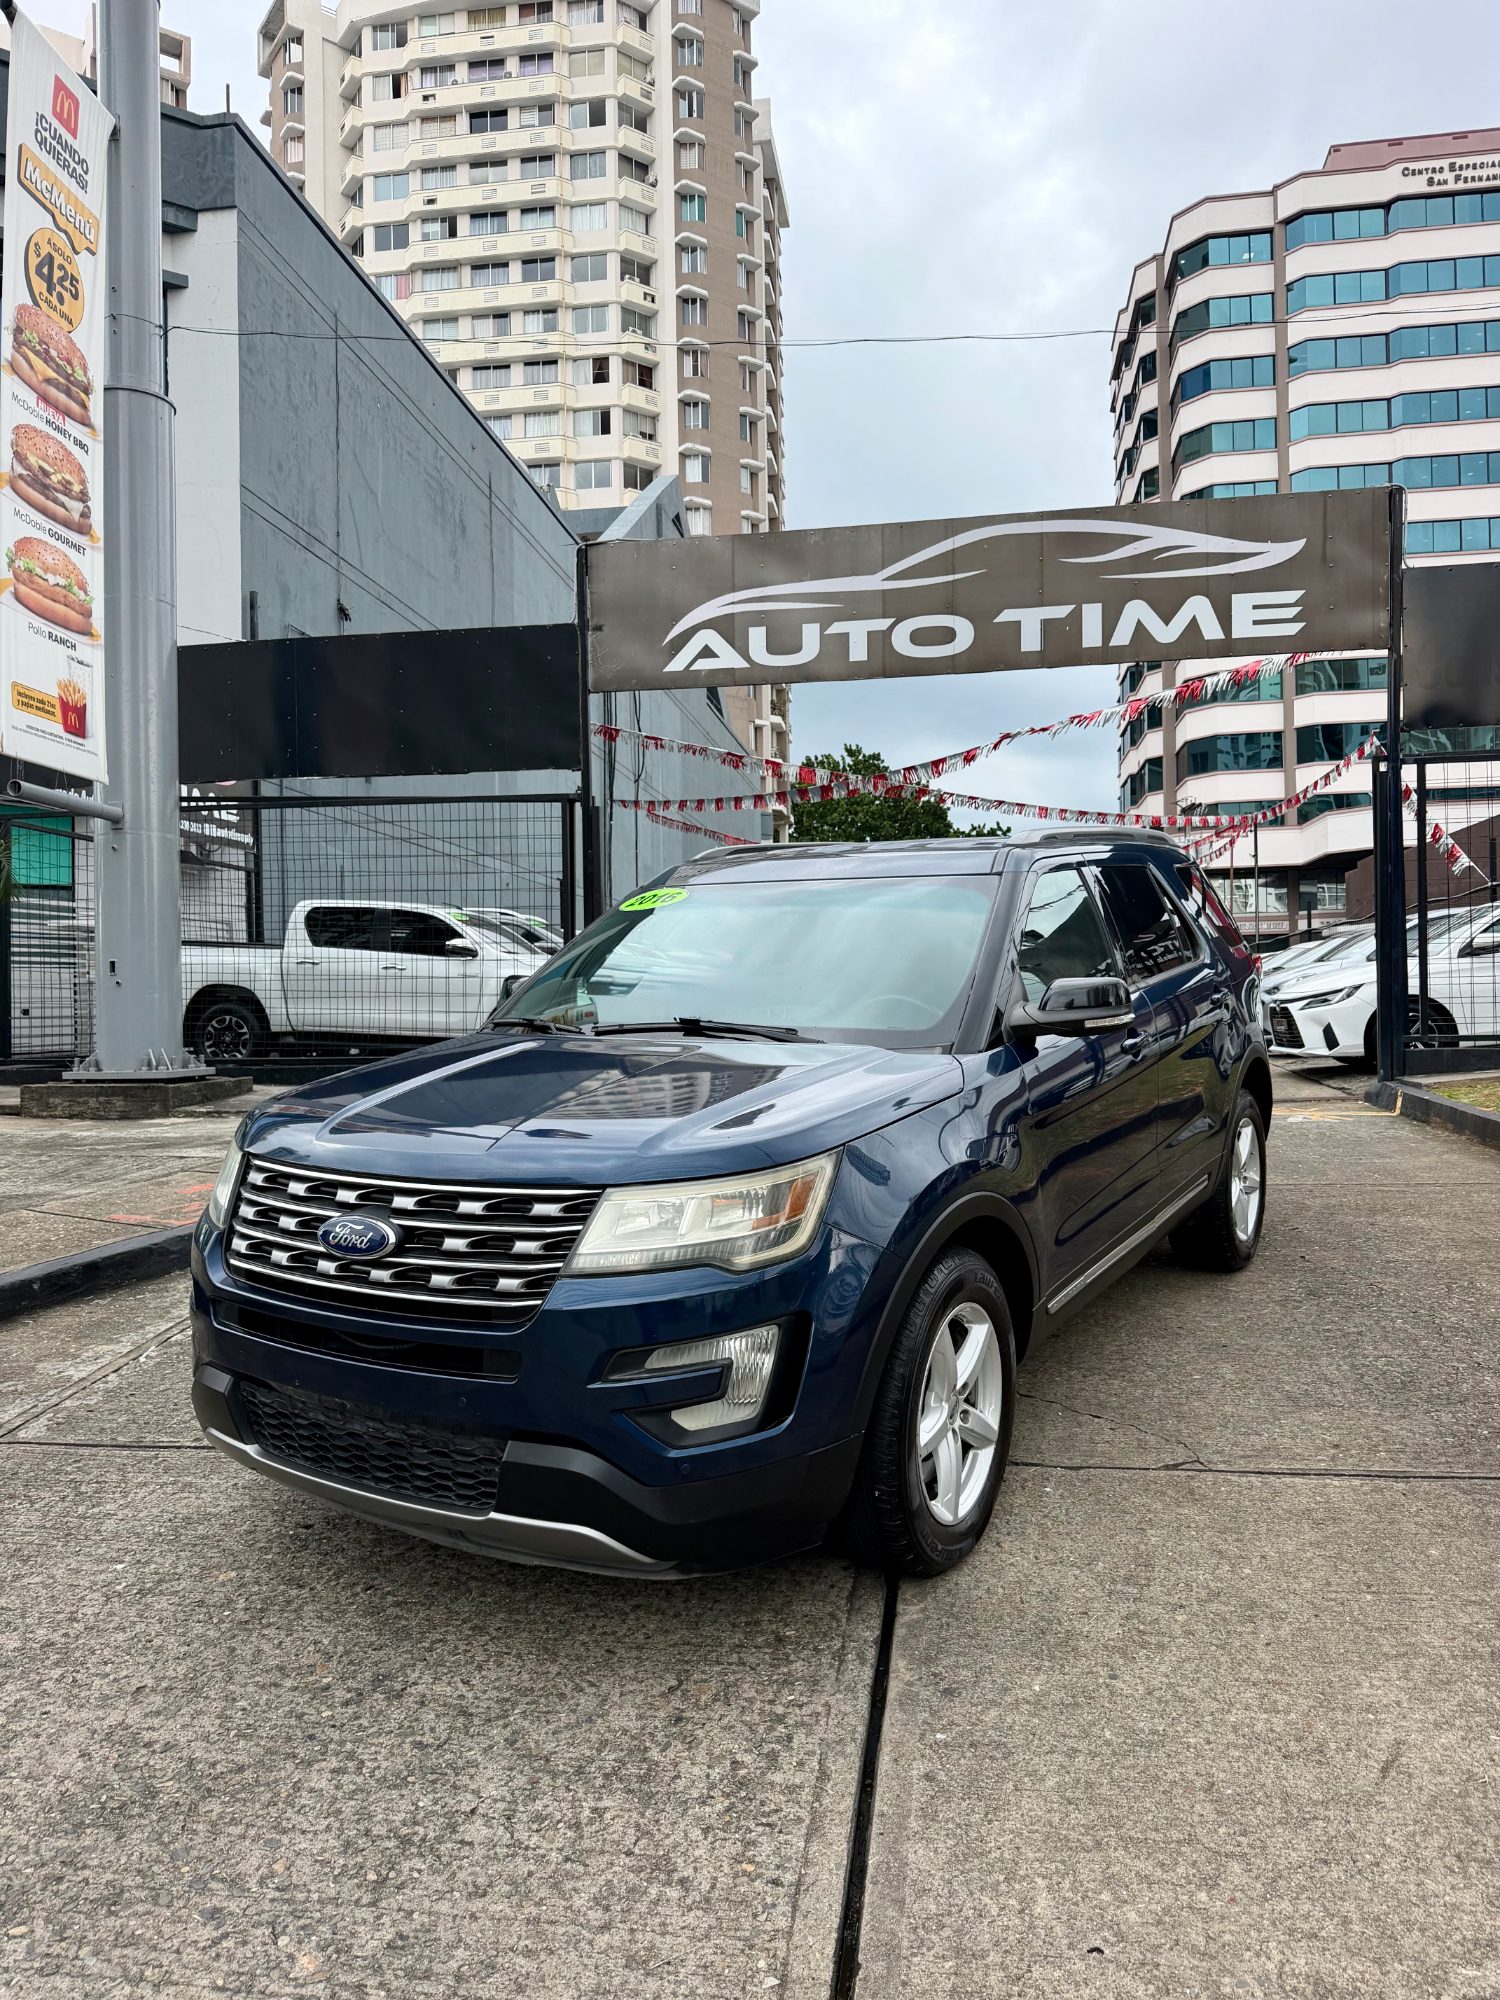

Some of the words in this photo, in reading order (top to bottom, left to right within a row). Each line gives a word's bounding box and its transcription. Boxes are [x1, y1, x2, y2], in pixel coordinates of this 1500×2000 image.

[34, 127, 88, 194] QUIERAS!
[35, 111, 89, 175] ¡CUANDO
[1401, 166, 1444, 177] CENTRO
[1426, 176, 1448, 187] SAN
[24, 156, 95, 244] McMenú
[39, 291, 58, 314] CADA
[60, 308, 74, 327] UNA
[12, 391, 45, 423] McDoble
[45, 416, 72, 441] HONEY
[73, 436, 90, 456] BBQ
[13, 507, 47, 534] McDoble
[47, 528, 87, 557] GOURMET
[28, 621, 47, 639] Pollo
[48, 631, 77, 652] RANCH
[663, 615, 975, 673] AUTO
[993, 590, 1307, 653] TIME
[625, 892, 682, 907] 2016
[328, 1221, 374, 1249] Ford
